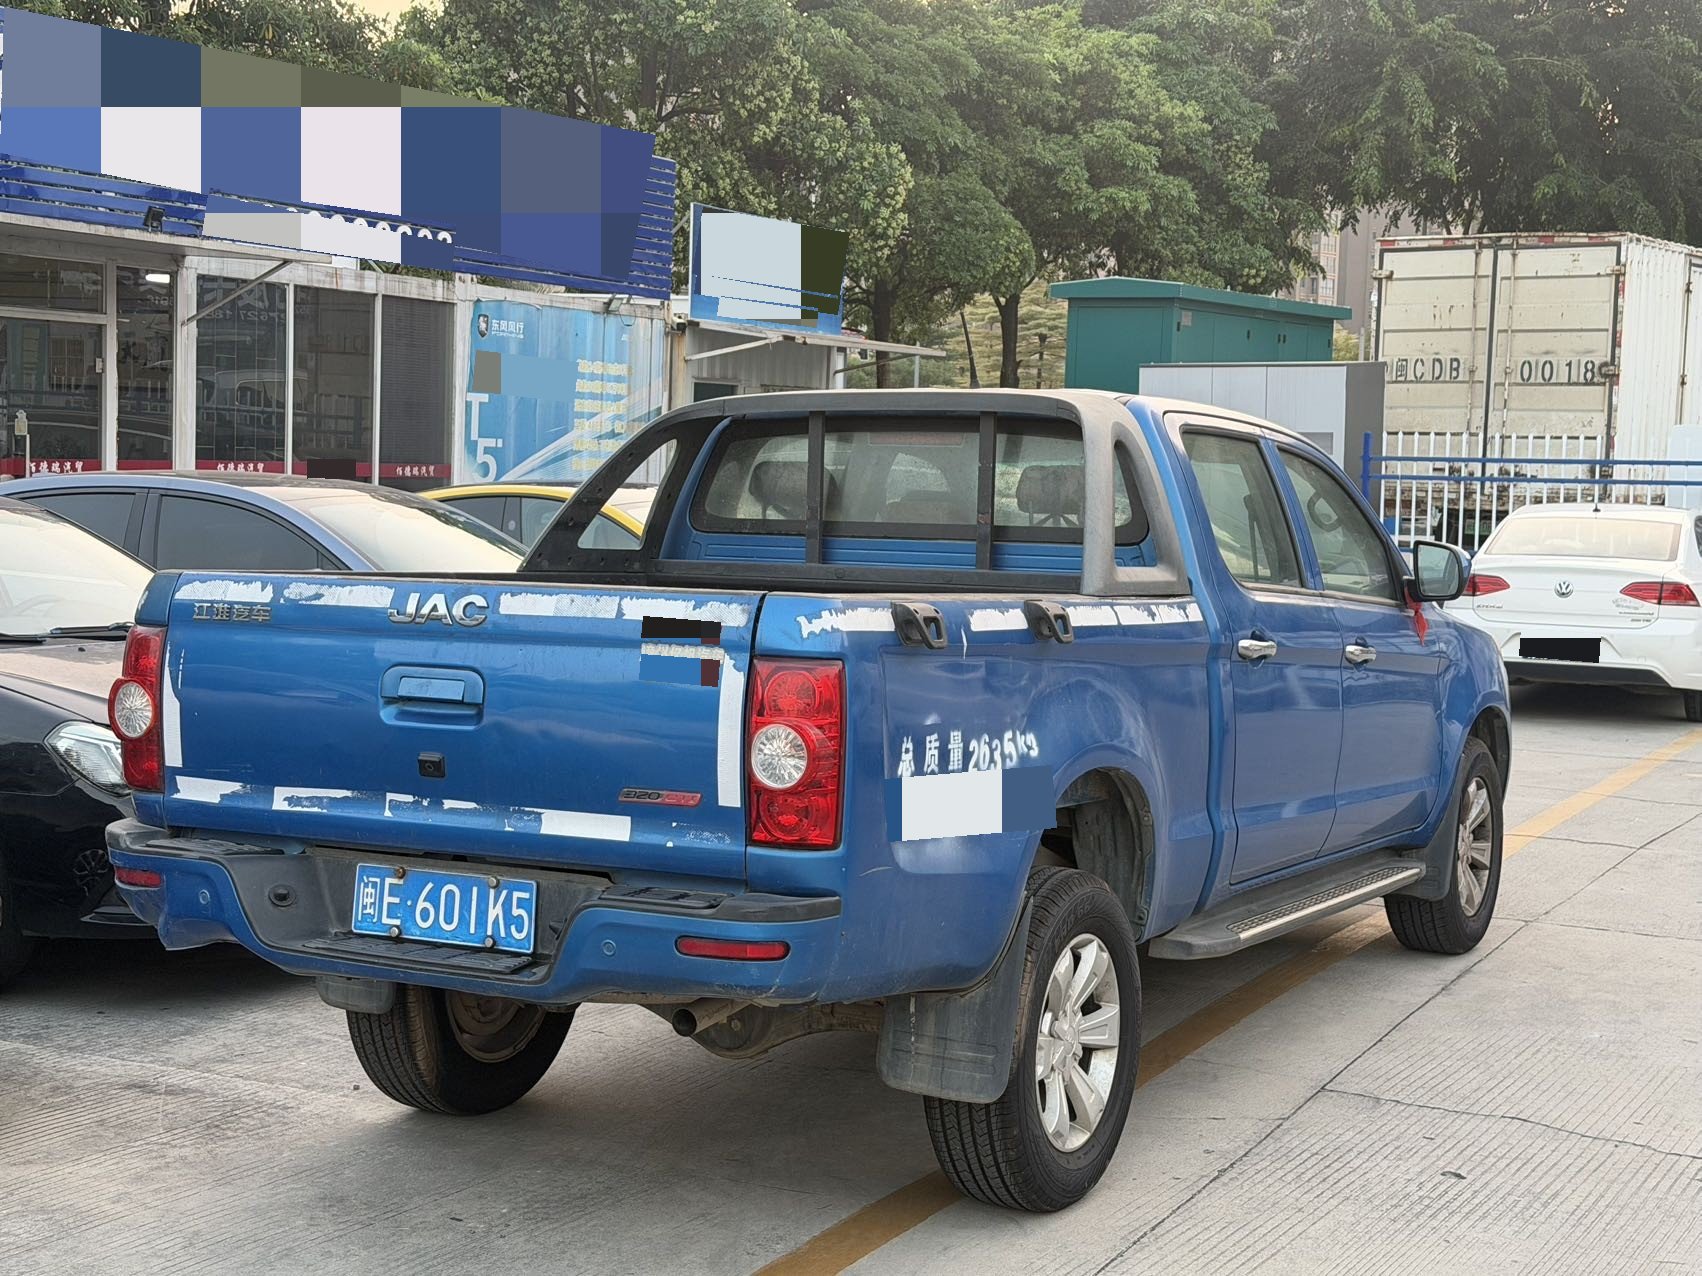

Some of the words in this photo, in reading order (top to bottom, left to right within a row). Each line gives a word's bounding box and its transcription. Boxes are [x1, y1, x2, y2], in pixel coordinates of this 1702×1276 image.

[491, 319, 525, 334] 东风风行
[1395, 357, 1461, 382] 闽CDB
[1519, 359, 1597, 383] 0018
[192, 602, 272, 622] 江淮汽车
[387, 592, 489, 628] JAC
